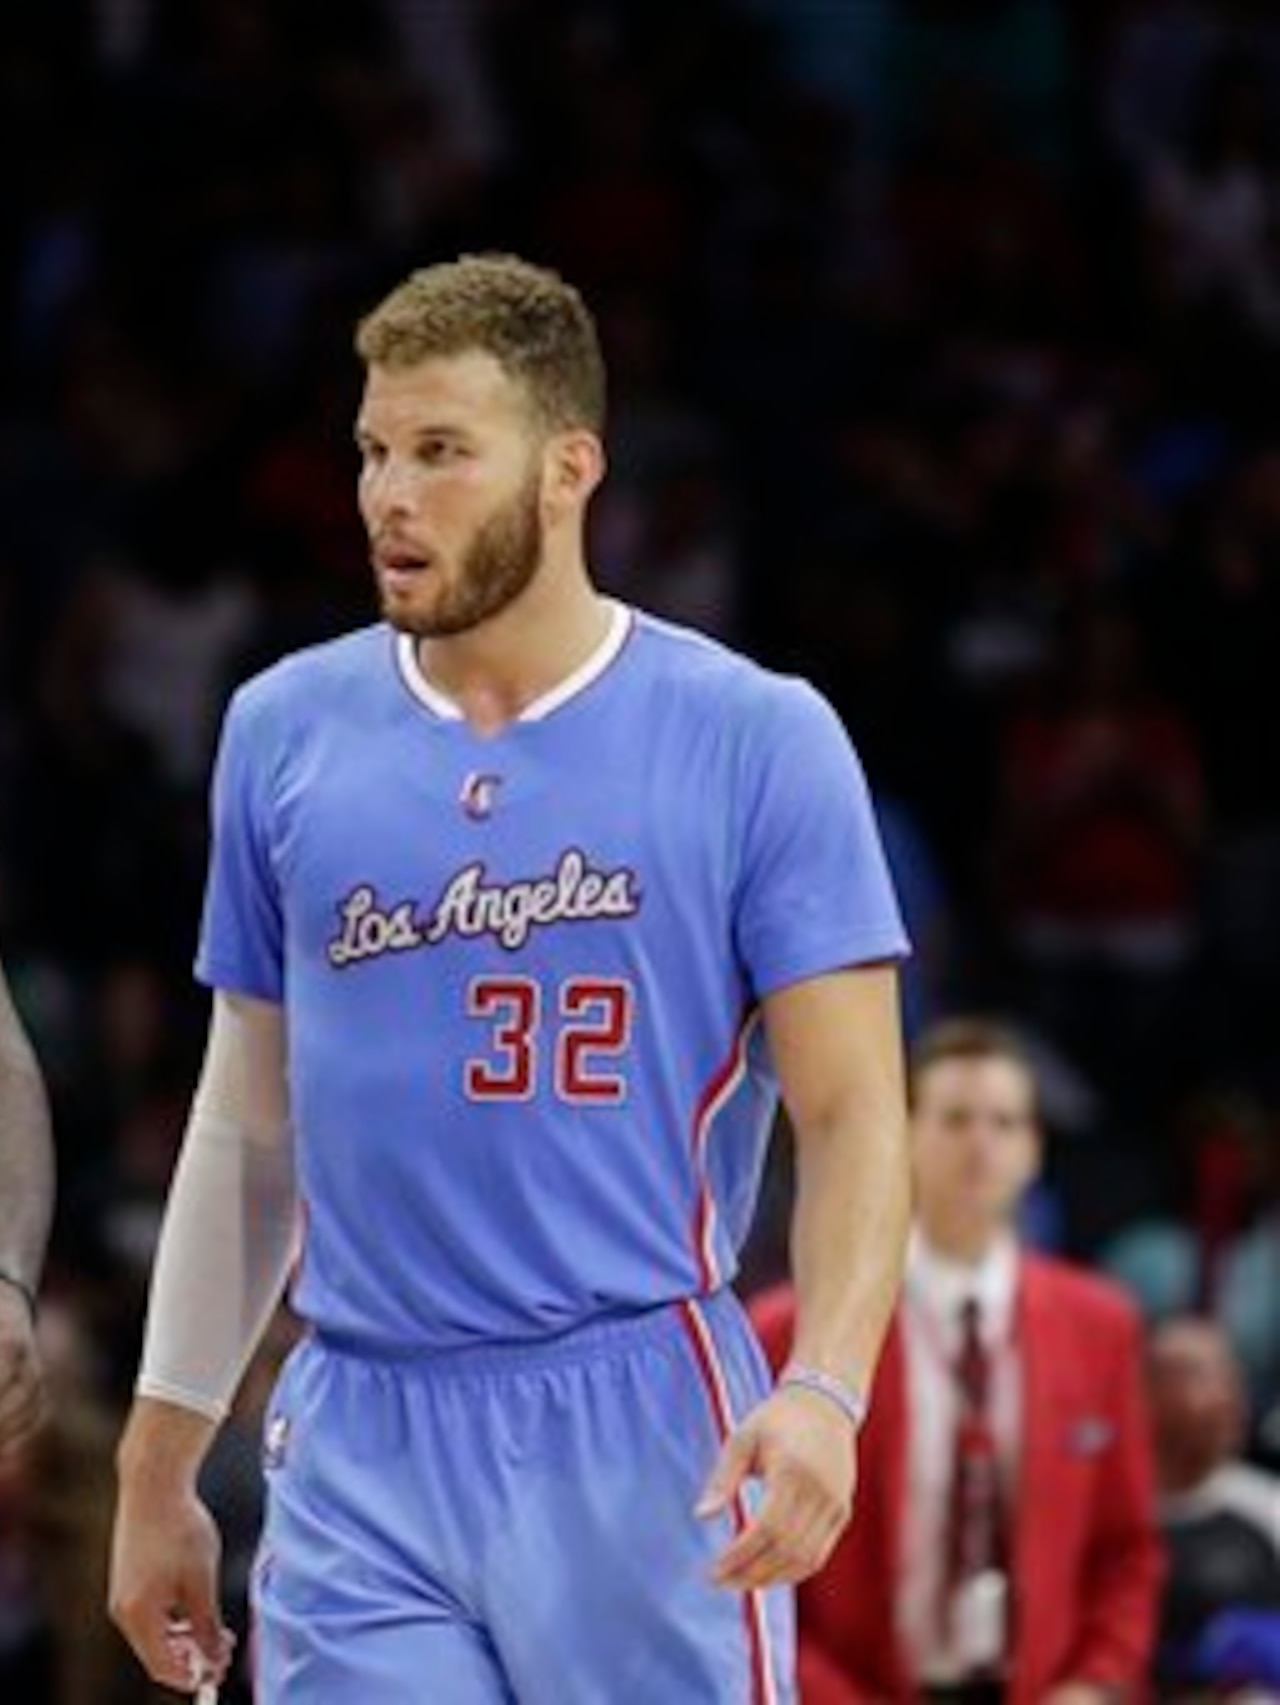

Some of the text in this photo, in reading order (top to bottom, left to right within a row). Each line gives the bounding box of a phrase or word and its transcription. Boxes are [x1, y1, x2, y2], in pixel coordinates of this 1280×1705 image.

[326, 847, 640, 969] Los Angeles
[463, 973, 633, 1104] 32
